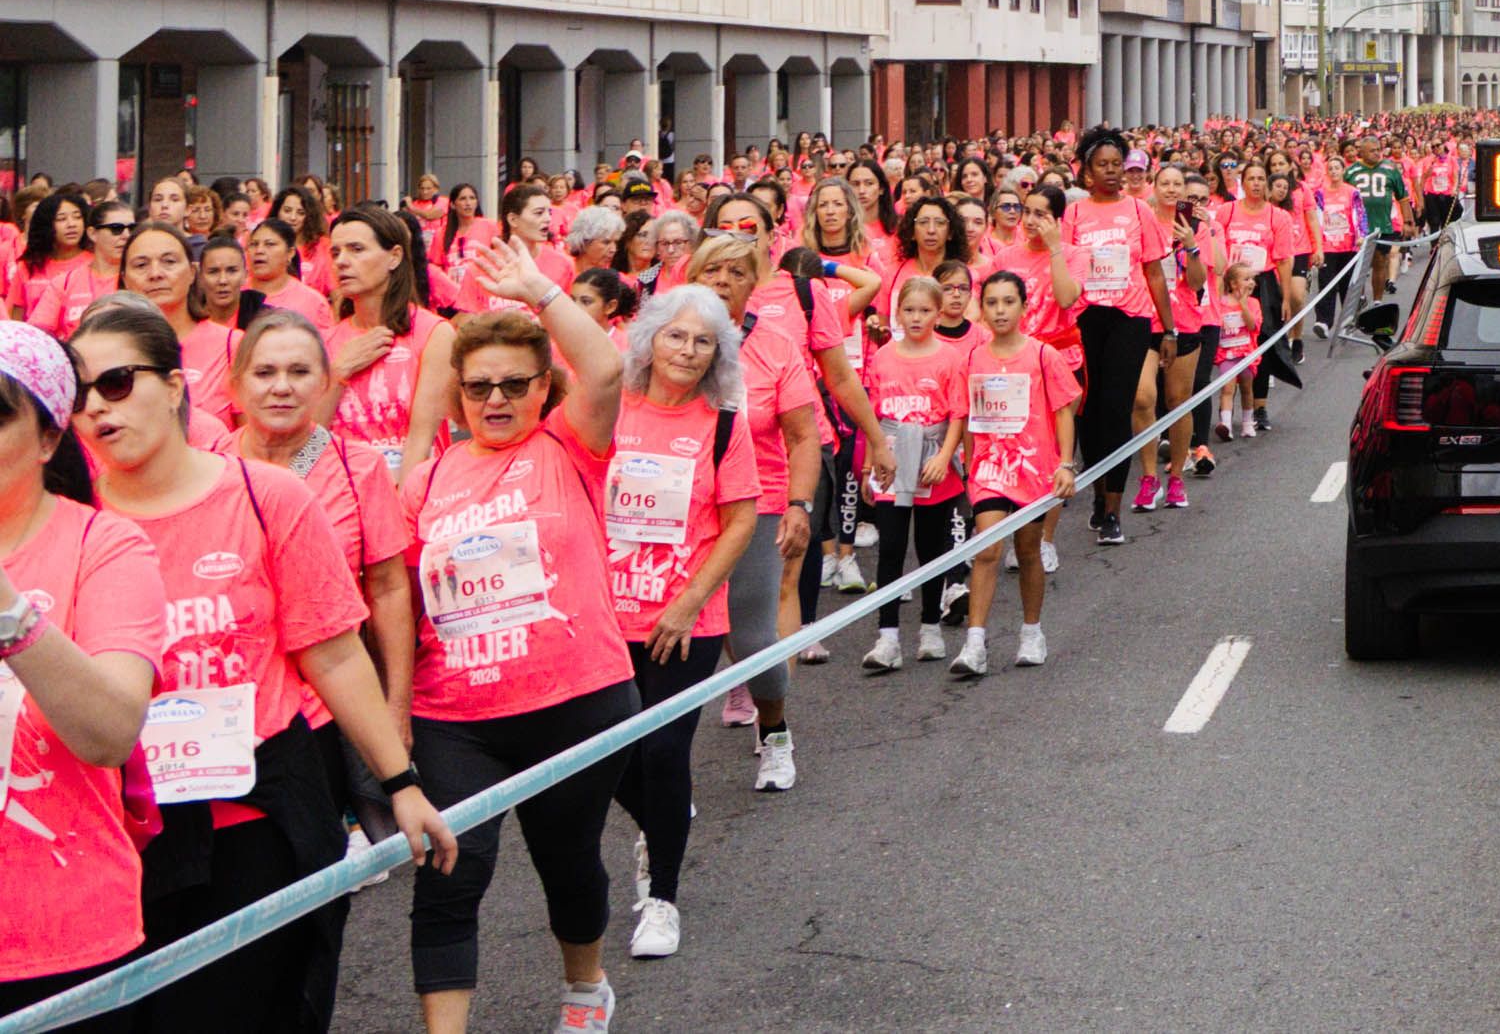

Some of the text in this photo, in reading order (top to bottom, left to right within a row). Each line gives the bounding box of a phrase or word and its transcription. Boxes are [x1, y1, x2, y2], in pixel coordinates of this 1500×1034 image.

[1355, 172, 1386, 197] 20
[985, 401, 1007, 411] 016
[620, 492, 656, 508] 016
[841, 471, 859, 534] adidas
[429, 488, 529, 541] CARRERA
[461, 573, 505, 597] 016
[611, 571, 665, 603] UJER
[444, 627, 528, 670] MUJER
[144, 740, 200, 762] 016
